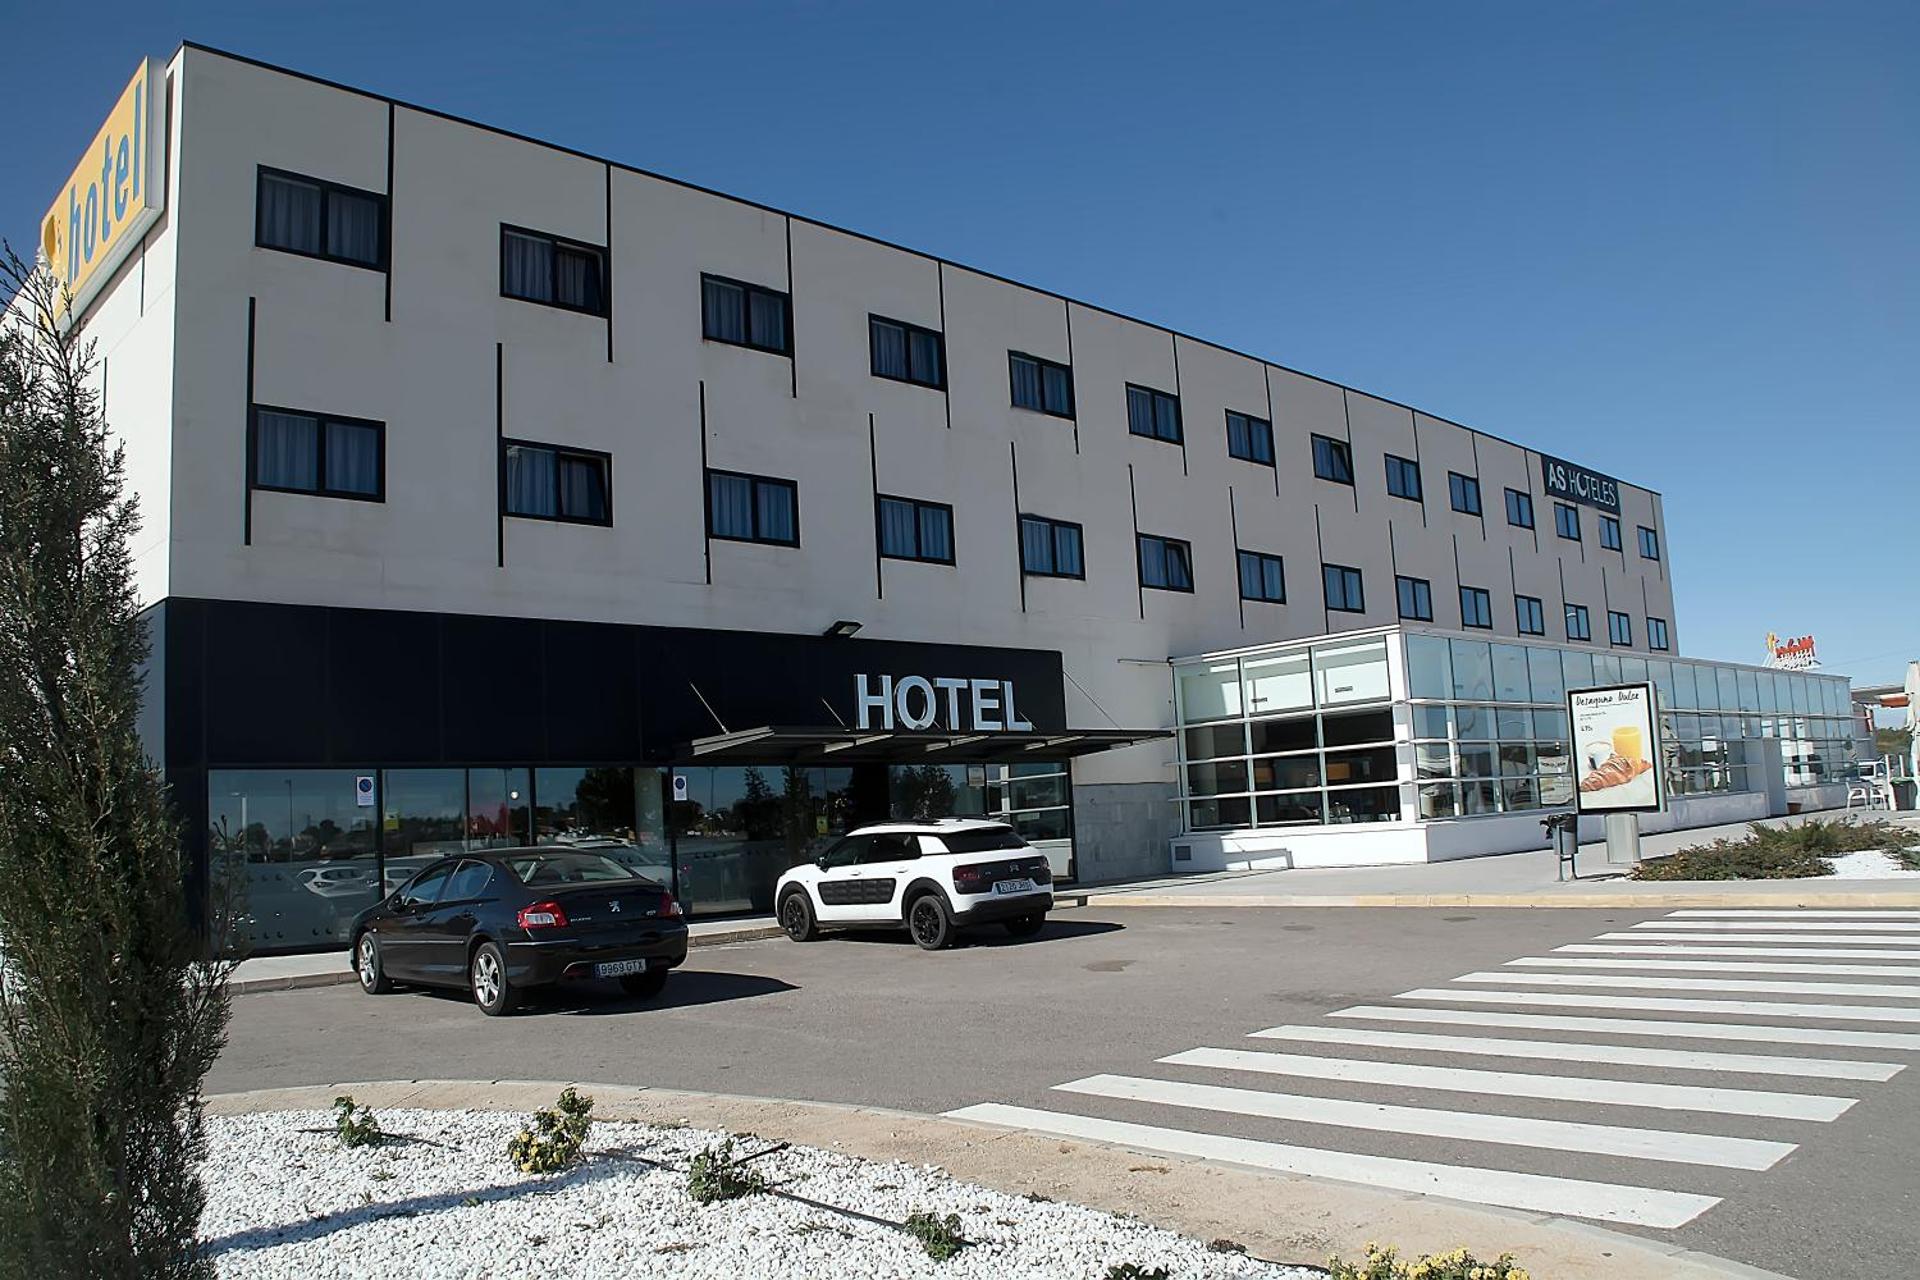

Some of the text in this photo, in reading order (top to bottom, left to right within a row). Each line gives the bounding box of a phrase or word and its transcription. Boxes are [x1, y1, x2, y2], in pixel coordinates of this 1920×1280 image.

[67, 80, 143, 287] hotel
[1548, 463, 1567, 491] AS
[853, 673, 1033, 732] HOTEL
